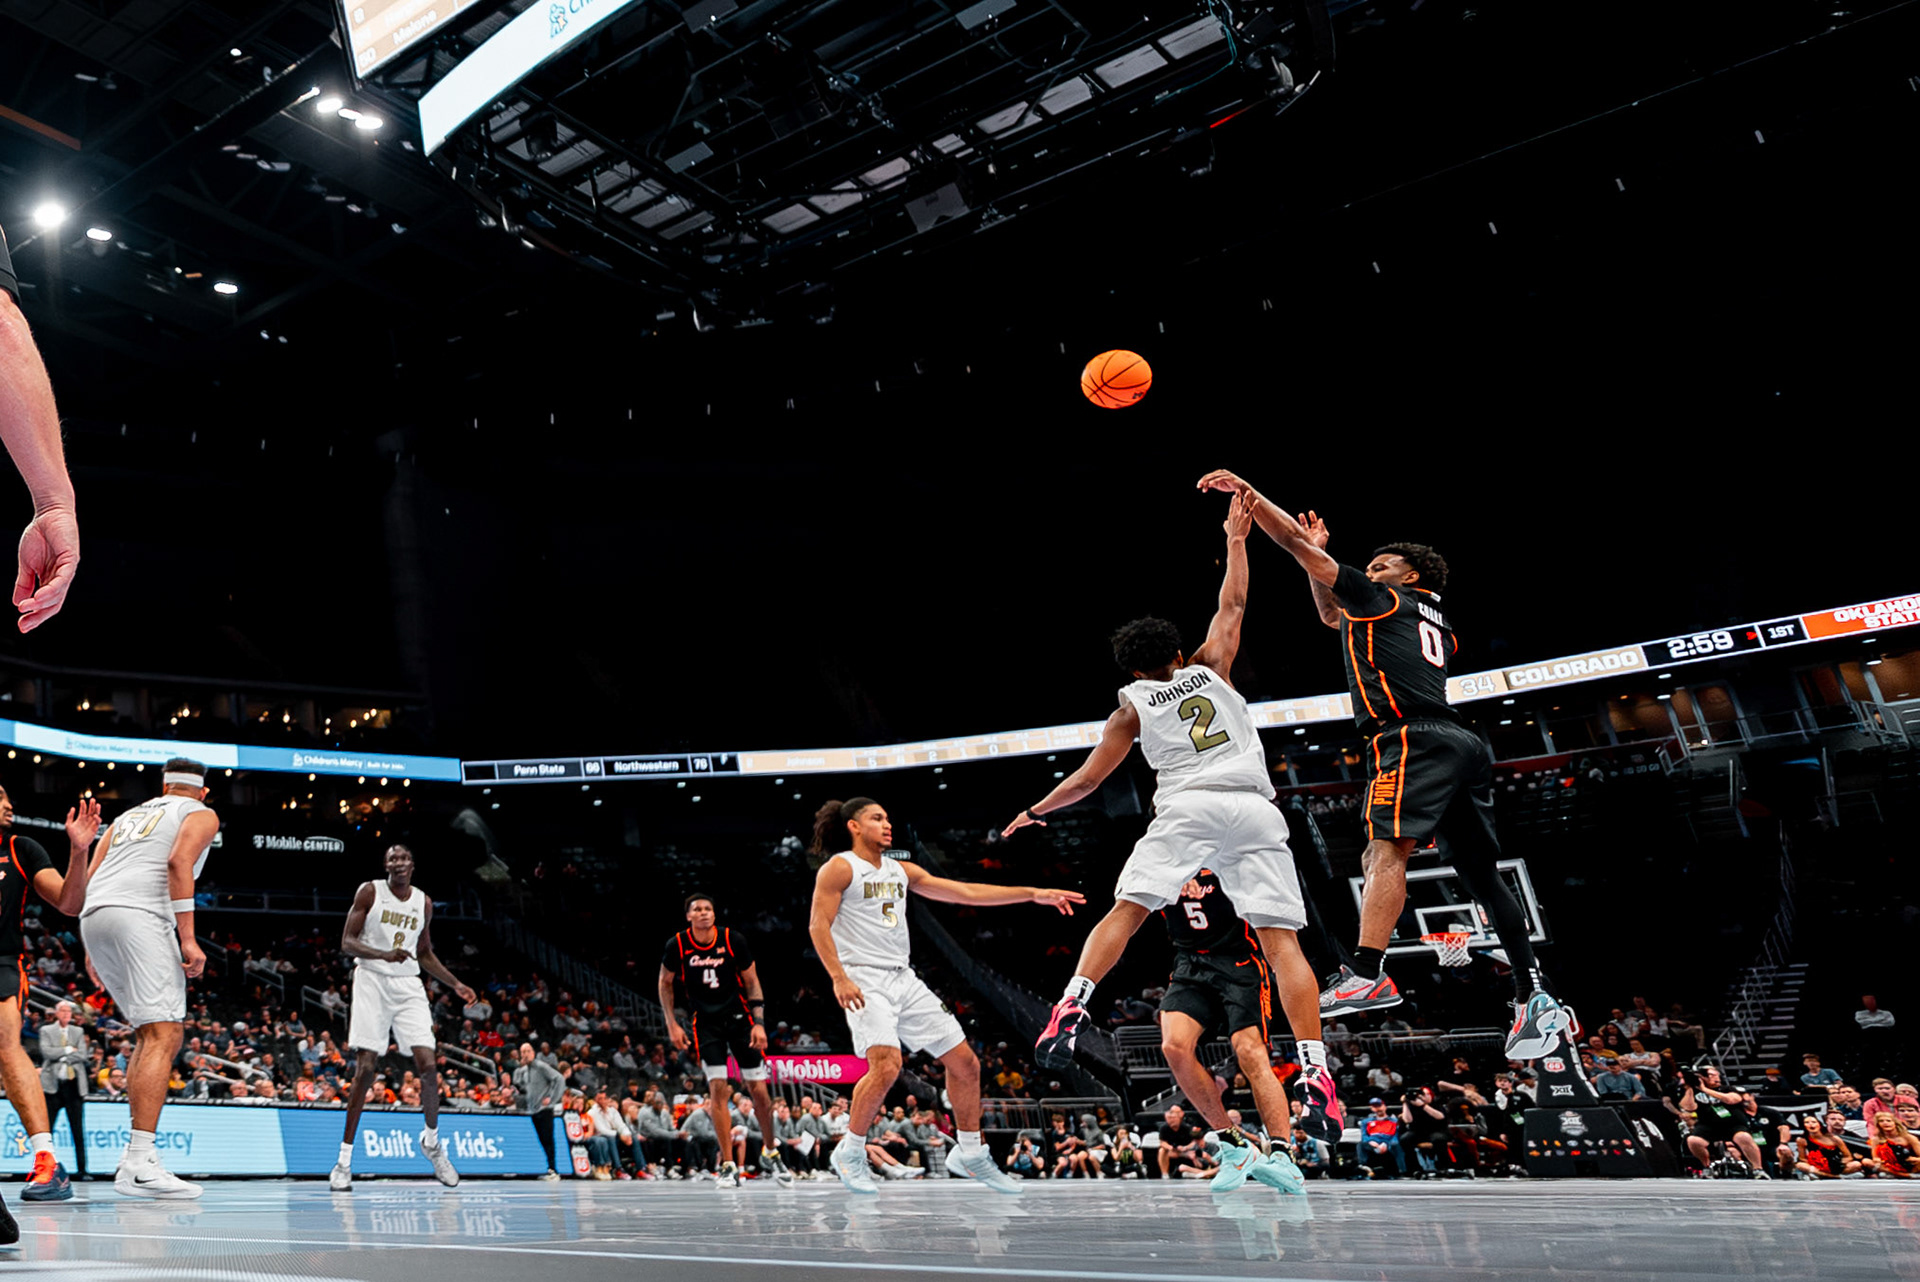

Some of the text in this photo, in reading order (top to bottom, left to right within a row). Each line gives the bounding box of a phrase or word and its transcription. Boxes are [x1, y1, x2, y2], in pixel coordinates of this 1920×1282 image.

[1767, 624, 1795, 639] 1ST
[1418, 620, 1445, 668] 0
[1667, 630, 1734, 659] 2:59
[1508, 651, 1639, 687] COLORADO
[1148, 671, 1212, 707] JOHNSON
[1460, 675, 1496, 697] 34
[1177, 695, 1231, 753] 2
[514, 763, 566, 776] Penn State
[614, 761, 679, 773] Northwestern
[111, 809, 166, 848] 50
[303, 840, 341, 852] CENTER
[864, 881, 904, 899] BUFFS
[381, 909, 419, 931] BUFFS
[882, 902, 898, 928] 5
[1183, 901, 1209, 930] 5
[393, 931, 406, 949] 8
[703, 968, 720, 988] 4
[776, 1058, 842, 1080] Mobile
[51, 1123, 193, 1156] hilren's ercy
[363, 1129, 416, 1158] Built
[453, 1130, 504, 1158] kids.
